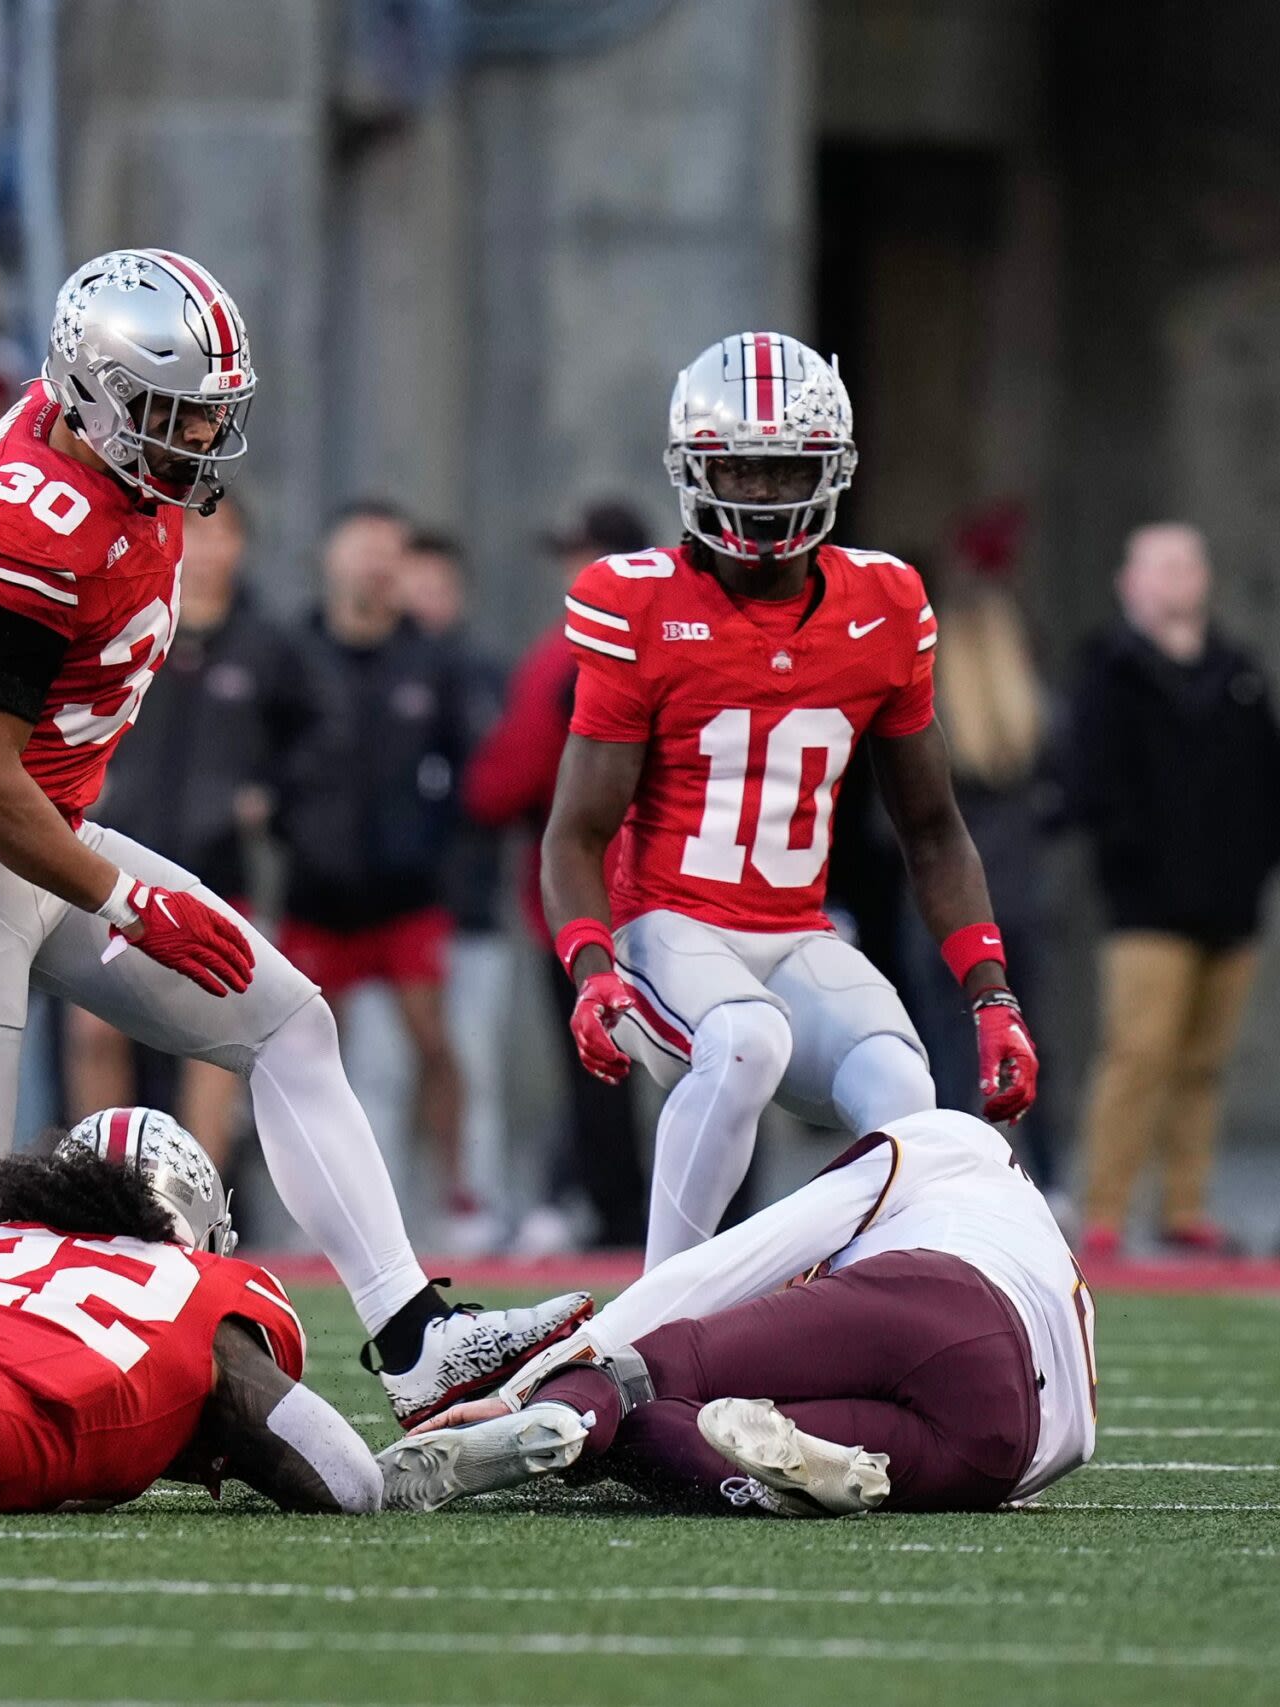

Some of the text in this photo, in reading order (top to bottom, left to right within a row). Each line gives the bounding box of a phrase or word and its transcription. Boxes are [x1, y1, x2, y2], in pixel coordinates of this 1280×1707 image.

[32, 401, 59, 438] UCKEYES
[595, 547, 676, 579] 0
[52, 560, 184, 747] 3
[680, 708, 855, 889] 10
